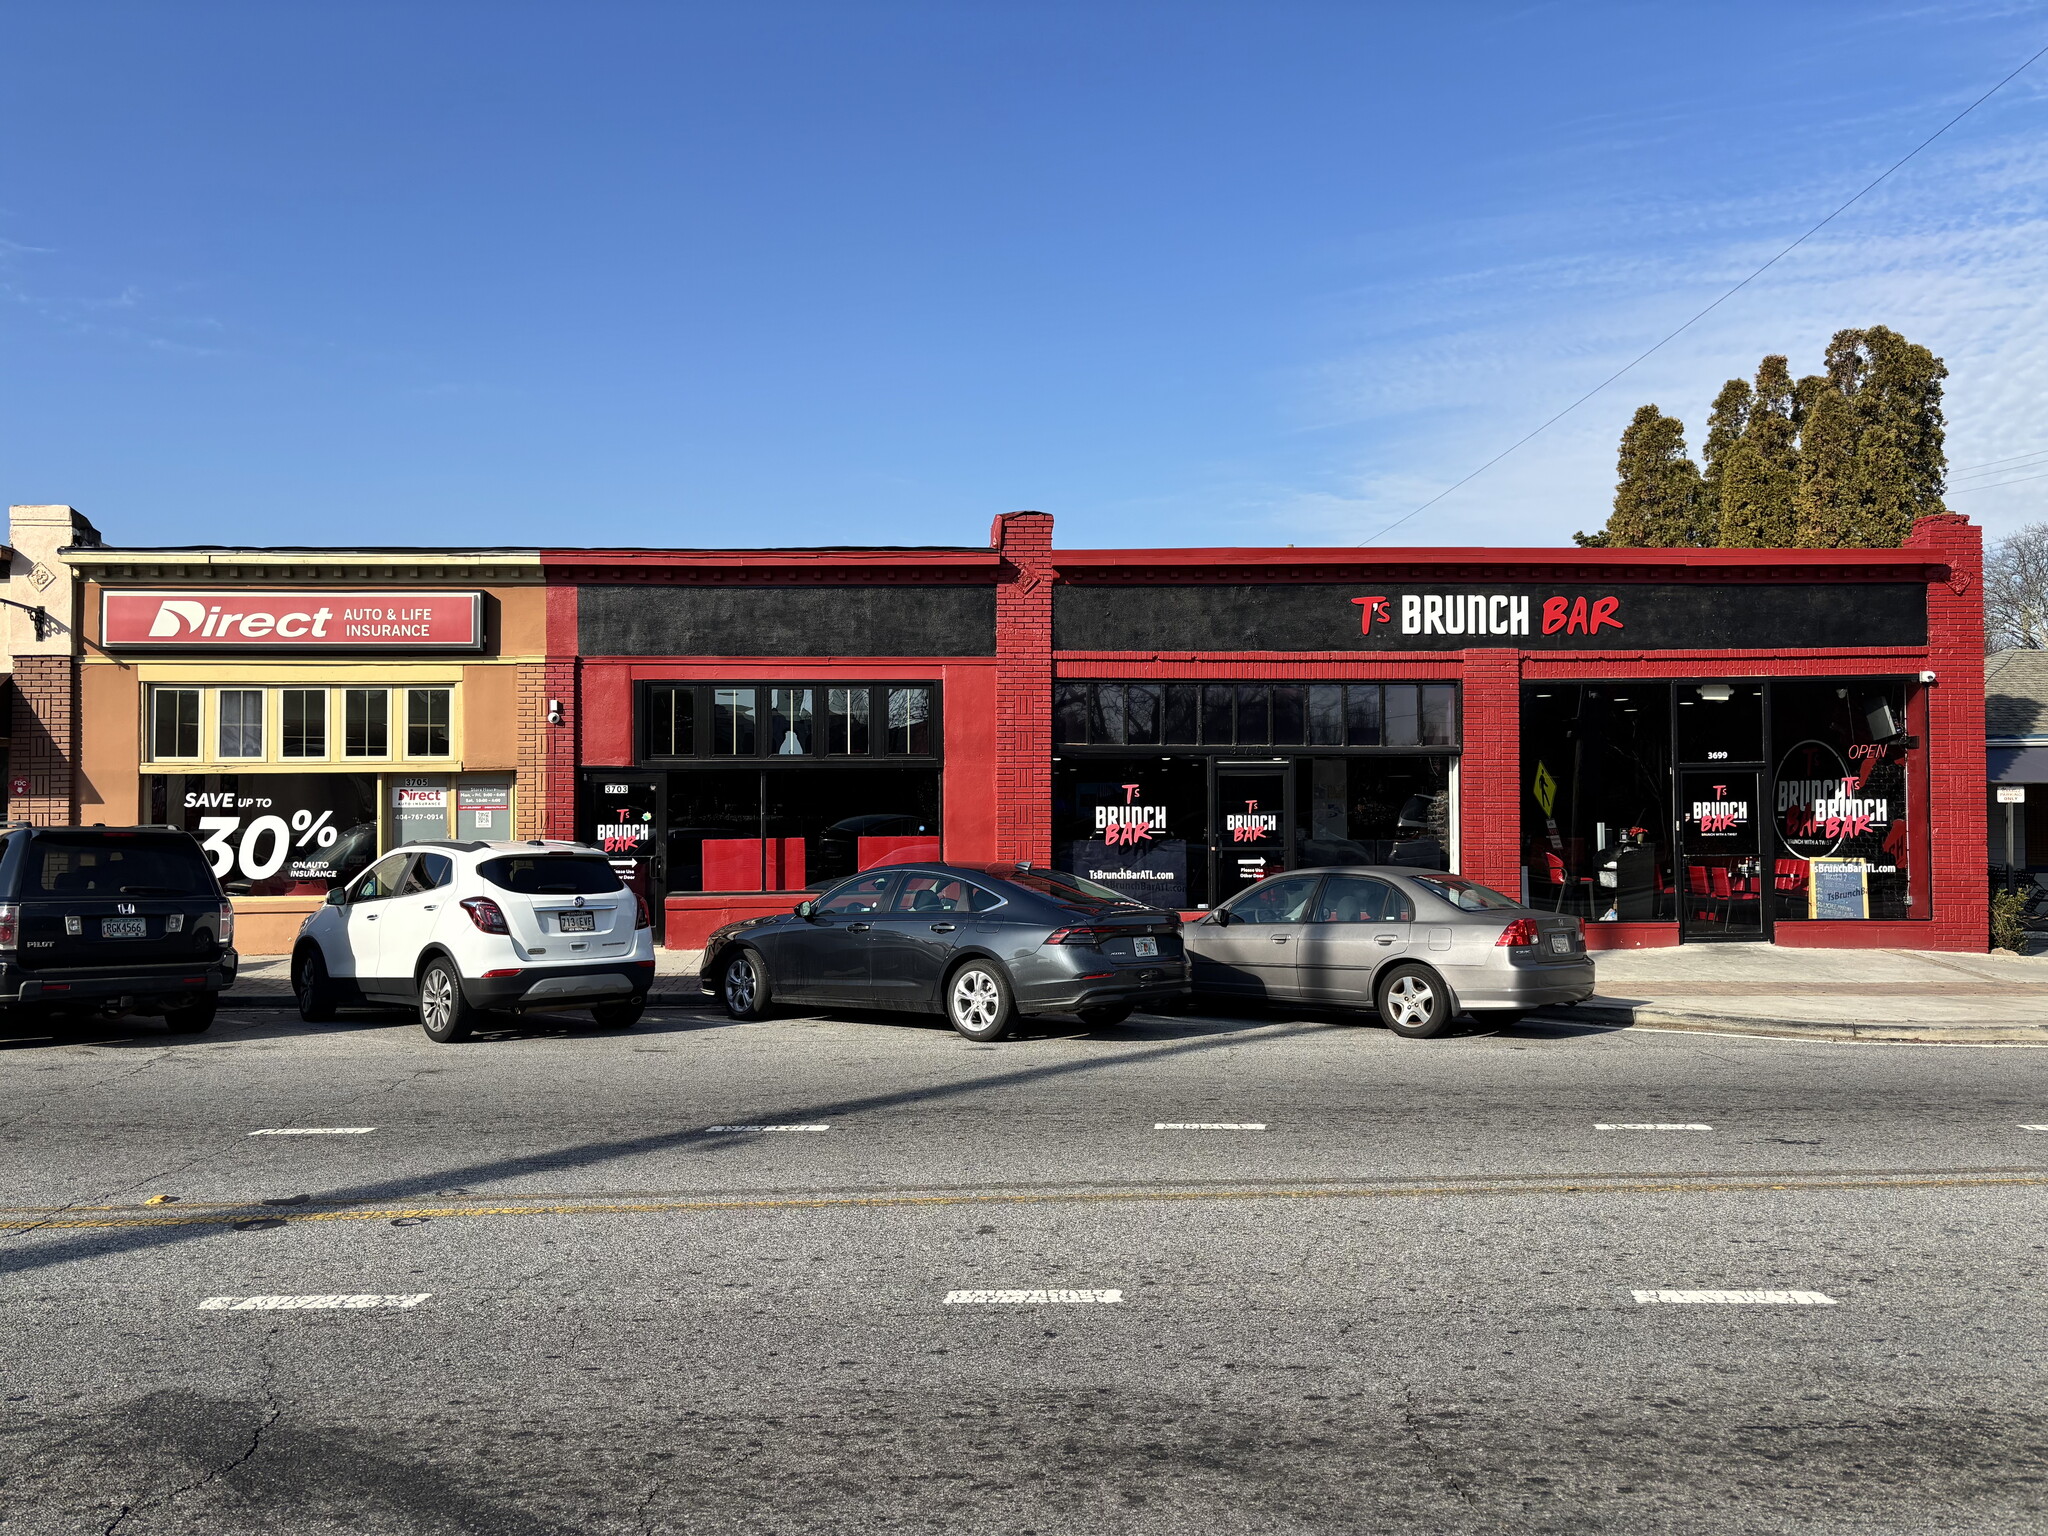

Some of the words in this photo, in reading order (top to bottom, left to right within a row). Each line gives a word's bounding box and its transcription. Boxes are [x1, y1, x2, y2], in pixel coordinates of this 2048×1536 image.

[148, 600, 333, 638] Direct
[343, 608, 383, 621] AUTO
[386, 608, 397, 621] &
[401, 608, 432, 621] LIFE
[1350, 595, 1391, 636] T's
[1401, 594, 1530, 636] BRUNCH
[1540, 595, 1624, 636] BAR
[345, 624, 430, 637] INSURANCE
[1707, 751, 1728, 760] 3699
[1848, 744, 1888, 759] OPEN
[405, 778, 428, 786] 3705
[606, 785, 628, 793] 3703
[1841, 776, 1860, 796] Ts
[183, 792, 235, 808] SAVE
[238, 798, 254, 808] UP
[255, 798, 272, 808] TO
[398, 789, 441, 801] Direct
[1121, 784, 1140, 804] Ts
[1712, 785, 1727, 800] Ts
[1245, 800, 1258, 814] Ts
[1693, 801, 1748, 819] BRUNCH
[1815, 799, 1888, 821] BRUNCH
[616, 809, 630, 823] Ts
[1095, 806, 1166, 828] BRUNCH
[1226, 815, 1277, 831] BRUNCH
[1701, 814, 1737, 832] BAR
[597, 824, 649, 840] BRUNCH
[1105, 822, 1152, 846] BAR
[1233, 826, 1266, 842] BAR
[1825, 815, 1873, 839] BAR
[198, 809, 338, 880] 30%
[604, 835, 639, 852] BAR
[292, 861, 306, 869] ON
[305, 861, 329, 869] AUTO
[1809, 863, 1896, 873] TsBrunchBarATL.com
[290, 870, 337, 878] INSURANCE
[1088, 869, 1174, 880] TsBrunchBarATL.com
[106, 922, 142, 933] RGK4566
[561, 917, 576, 928] 713
